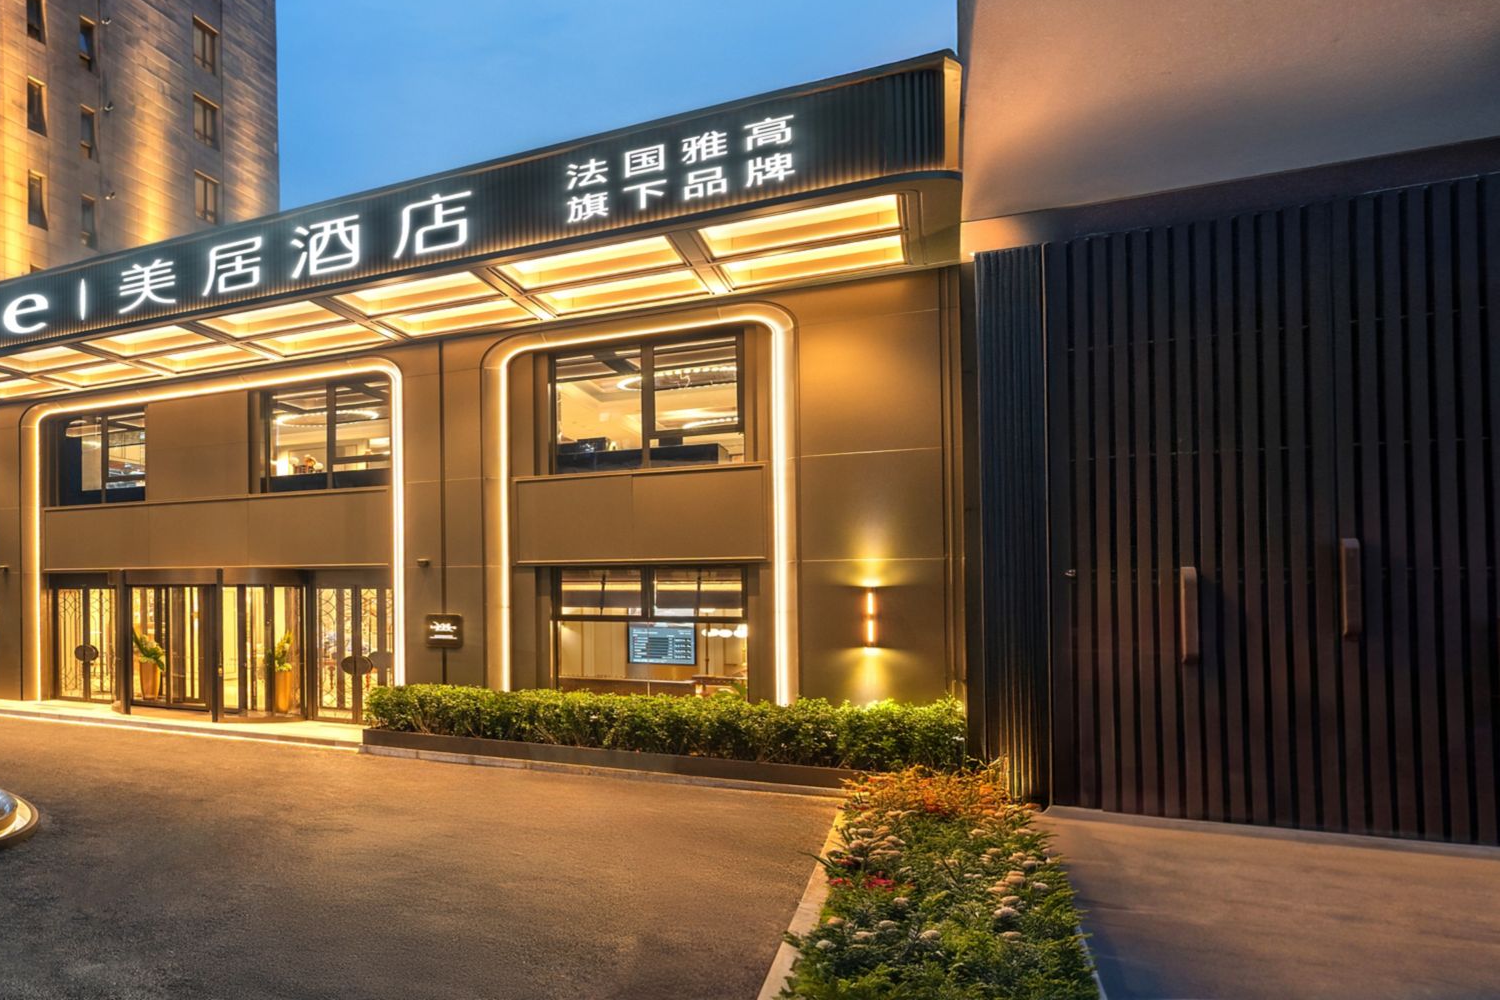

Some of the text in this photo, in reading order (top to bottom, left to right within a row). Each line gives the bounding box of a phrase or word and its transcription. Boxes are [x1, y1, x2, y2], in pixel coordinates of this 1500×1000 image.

[567, 114, 795, 190] 法国雅高
[567, 153, 795, 223] 旗下品牌
[119, 190, 472, 314] 美居酒店
